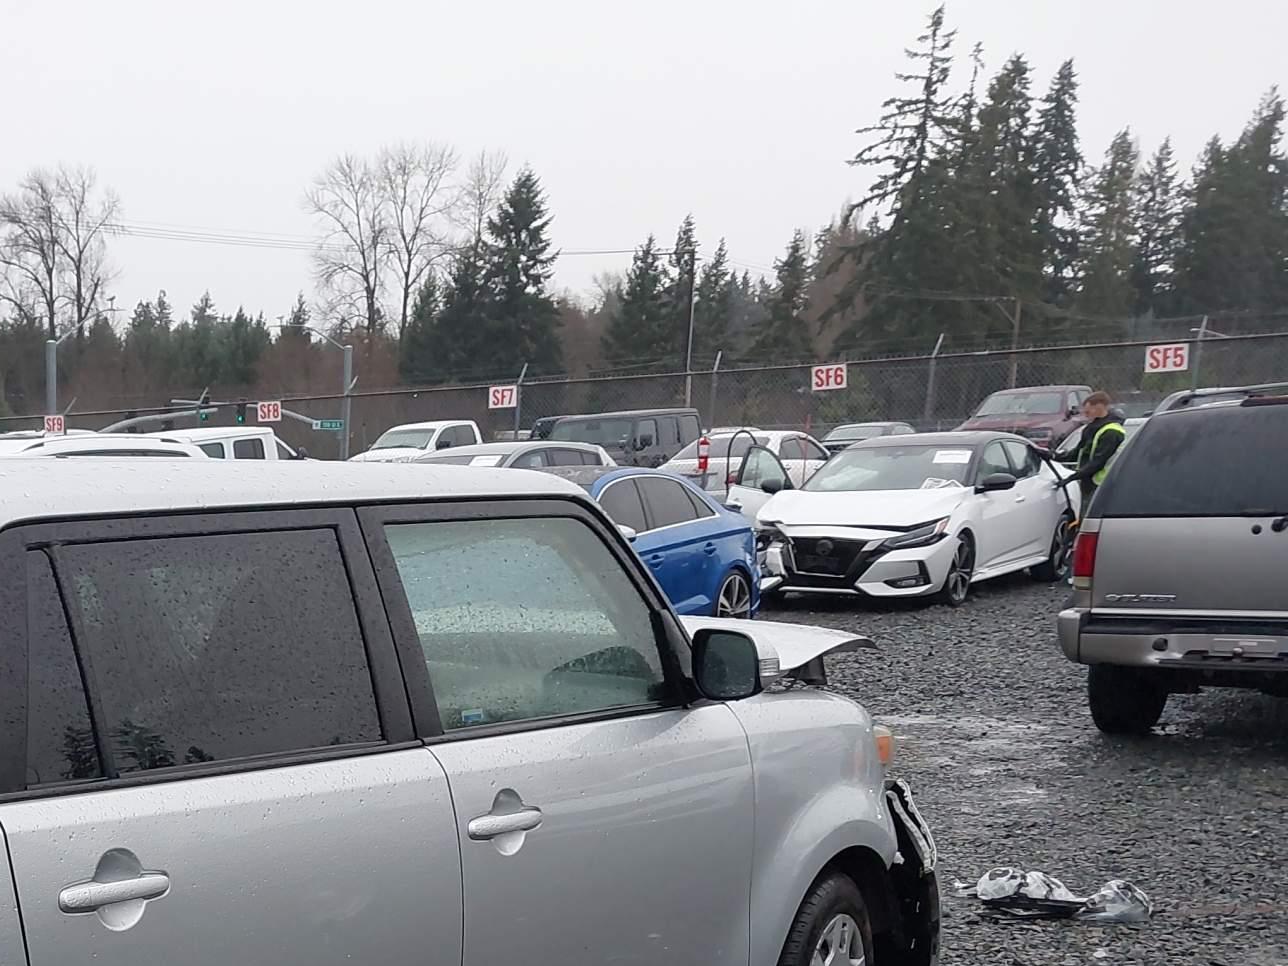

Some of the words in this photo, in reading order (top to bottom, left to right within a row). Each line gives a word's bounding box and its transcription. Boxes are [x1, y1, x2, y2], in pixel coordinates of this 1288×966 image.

[1149, 346, 1185, 369] SF5
[815, 367, 844, 387] SF6
[492, 388, 513, 406] SF7
[259, 403, 280, 420] SF8
[46, 417, 63, 432] SF9
